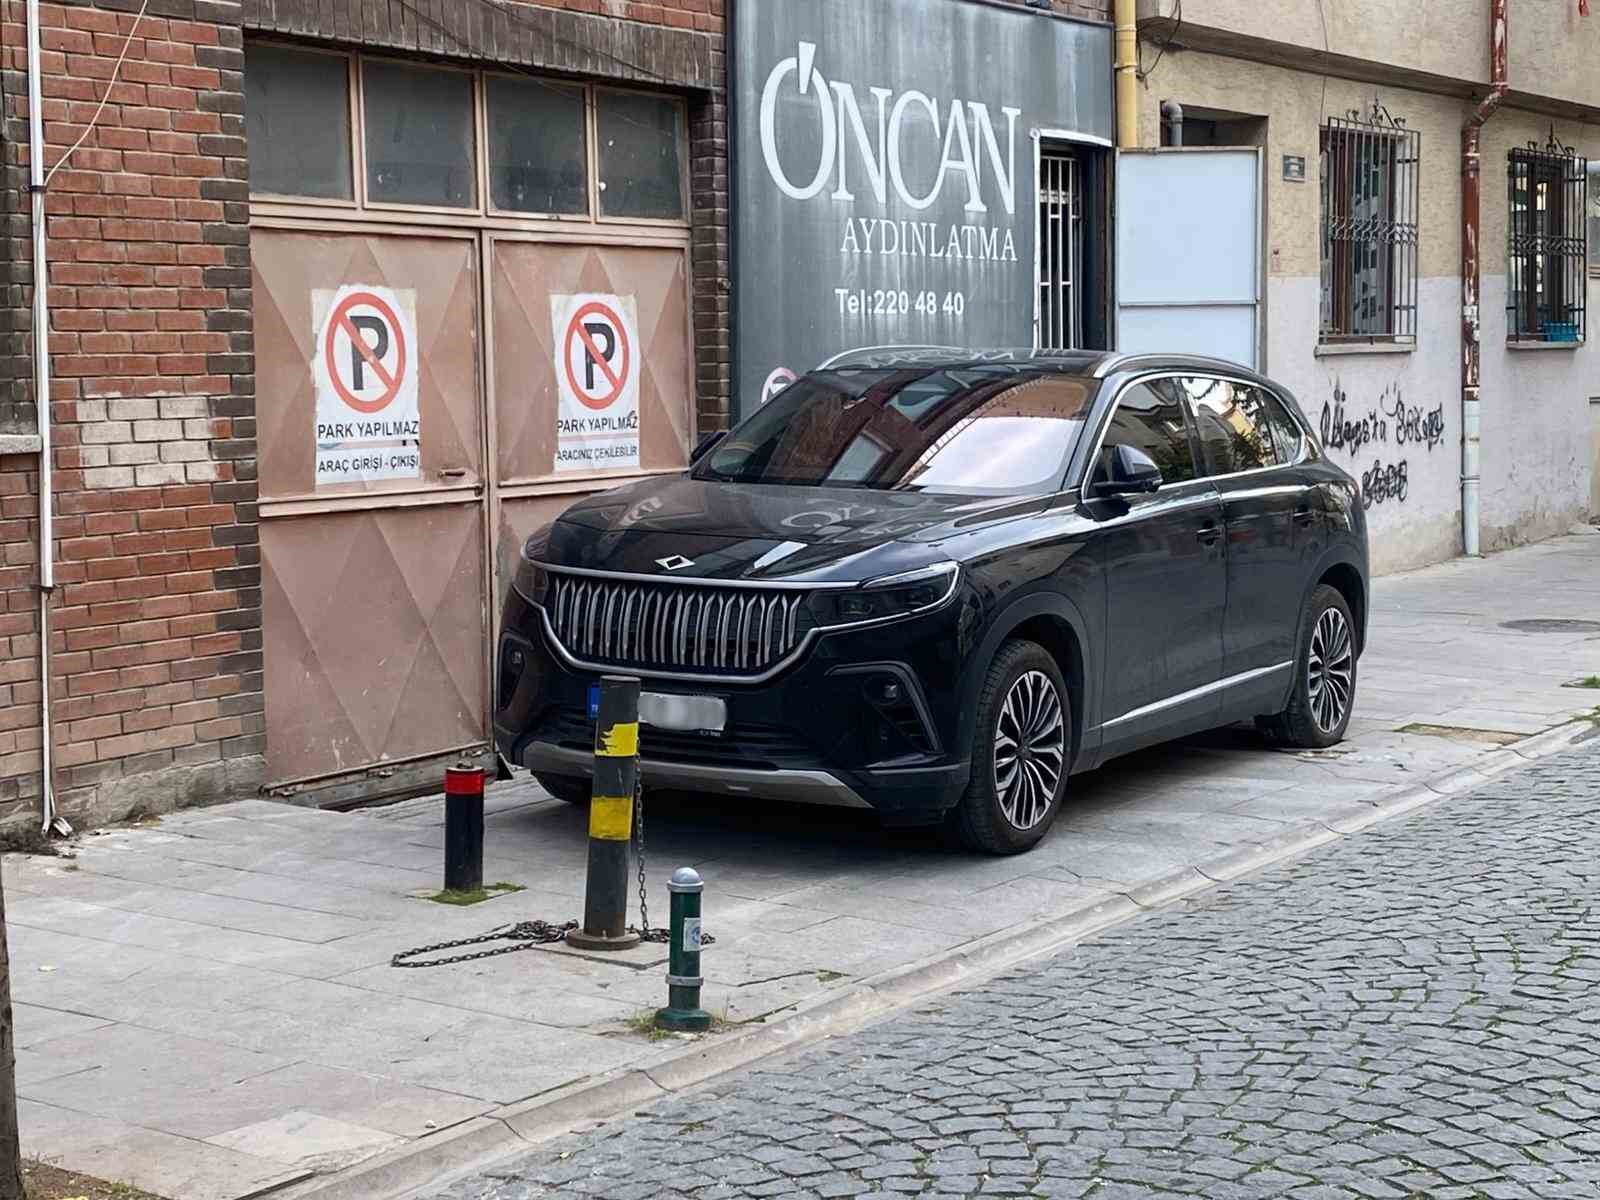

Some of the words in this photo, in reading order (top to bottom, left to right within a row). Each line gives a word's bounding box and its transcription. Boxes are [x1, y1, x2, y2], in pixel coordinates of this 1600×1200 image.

[840, 217, 1018, 261] AYDINLATMA
[915, 290, 937, 315] 48
[943, 291, 965, 316] 40
[318, 423, 354, 439] PARK
[357, 420, 419, 437] YAPILMAZ
[557, 418, 587, 433] PARK
[589, 415, 638, 431] YAPILMAZ
[318, 459, 350, 473] ARAÇ
